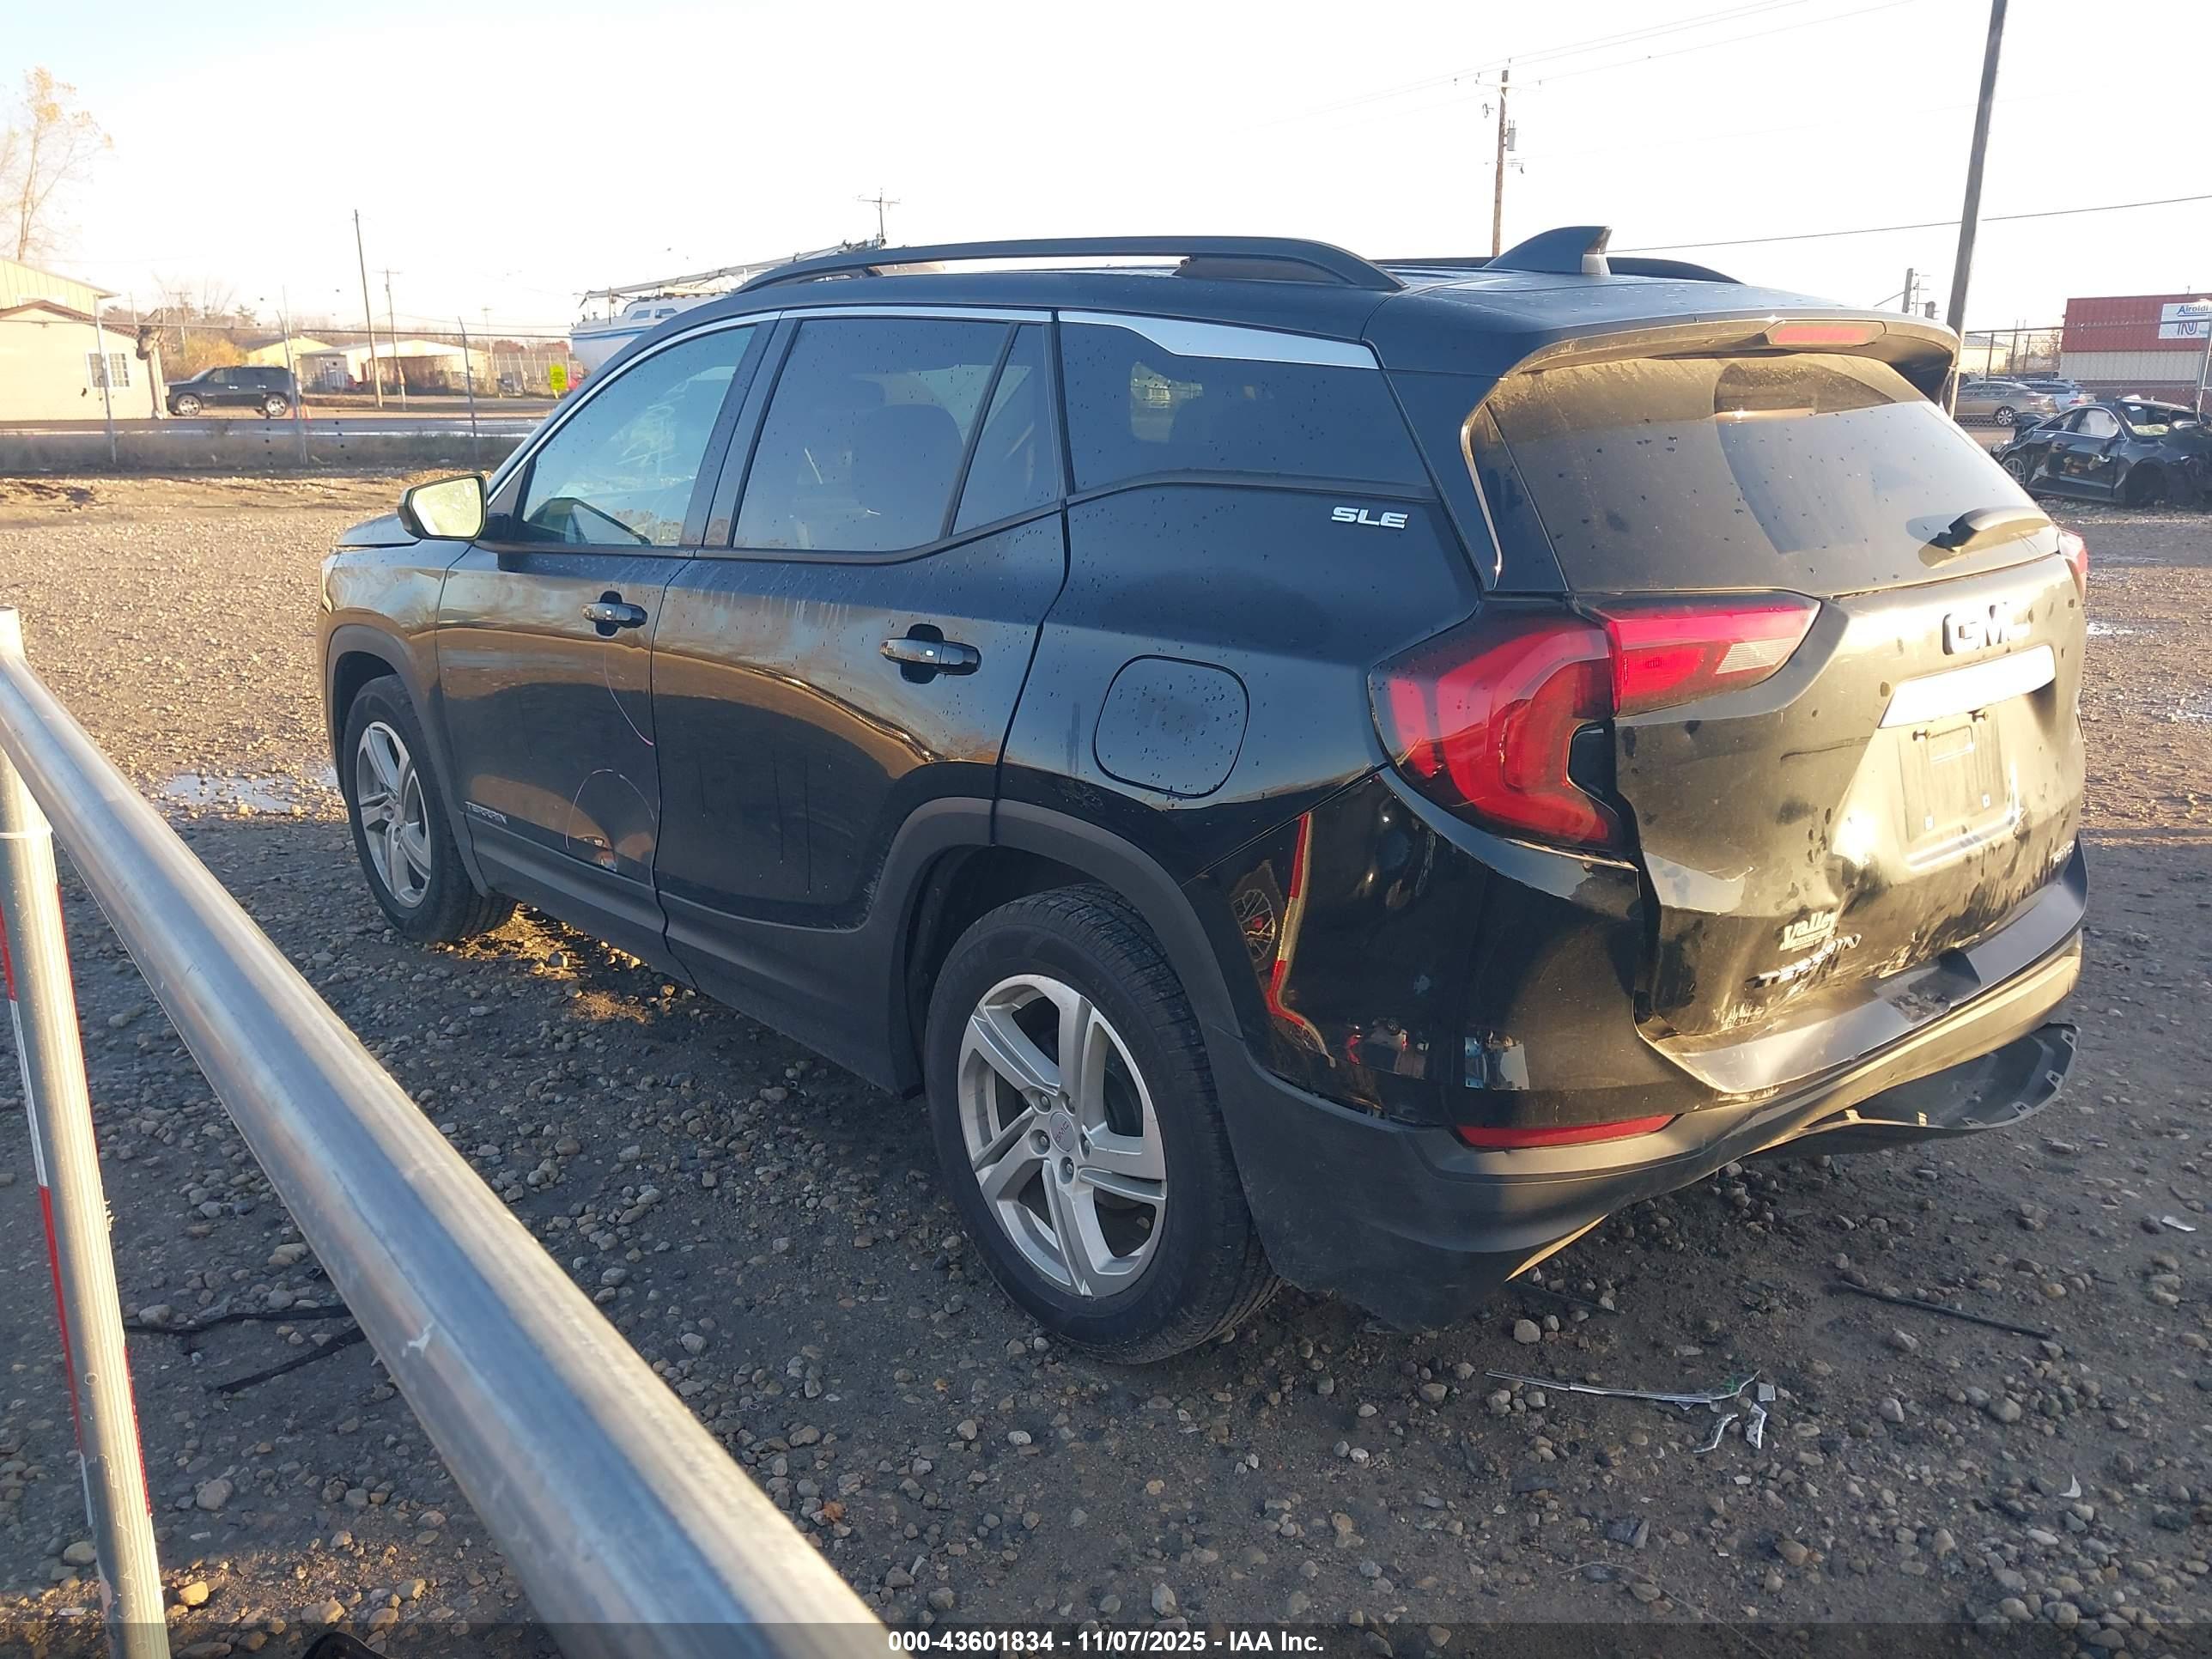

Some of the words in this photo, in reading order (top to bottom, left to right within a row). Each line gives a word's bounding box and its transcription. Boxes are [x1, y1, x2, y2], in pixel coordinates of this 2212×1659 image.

[1331, 506, 1408, 529] SLE
[1942, 602, 2032, 655] GMC
[1778, 911, 1839, 951] Valley
